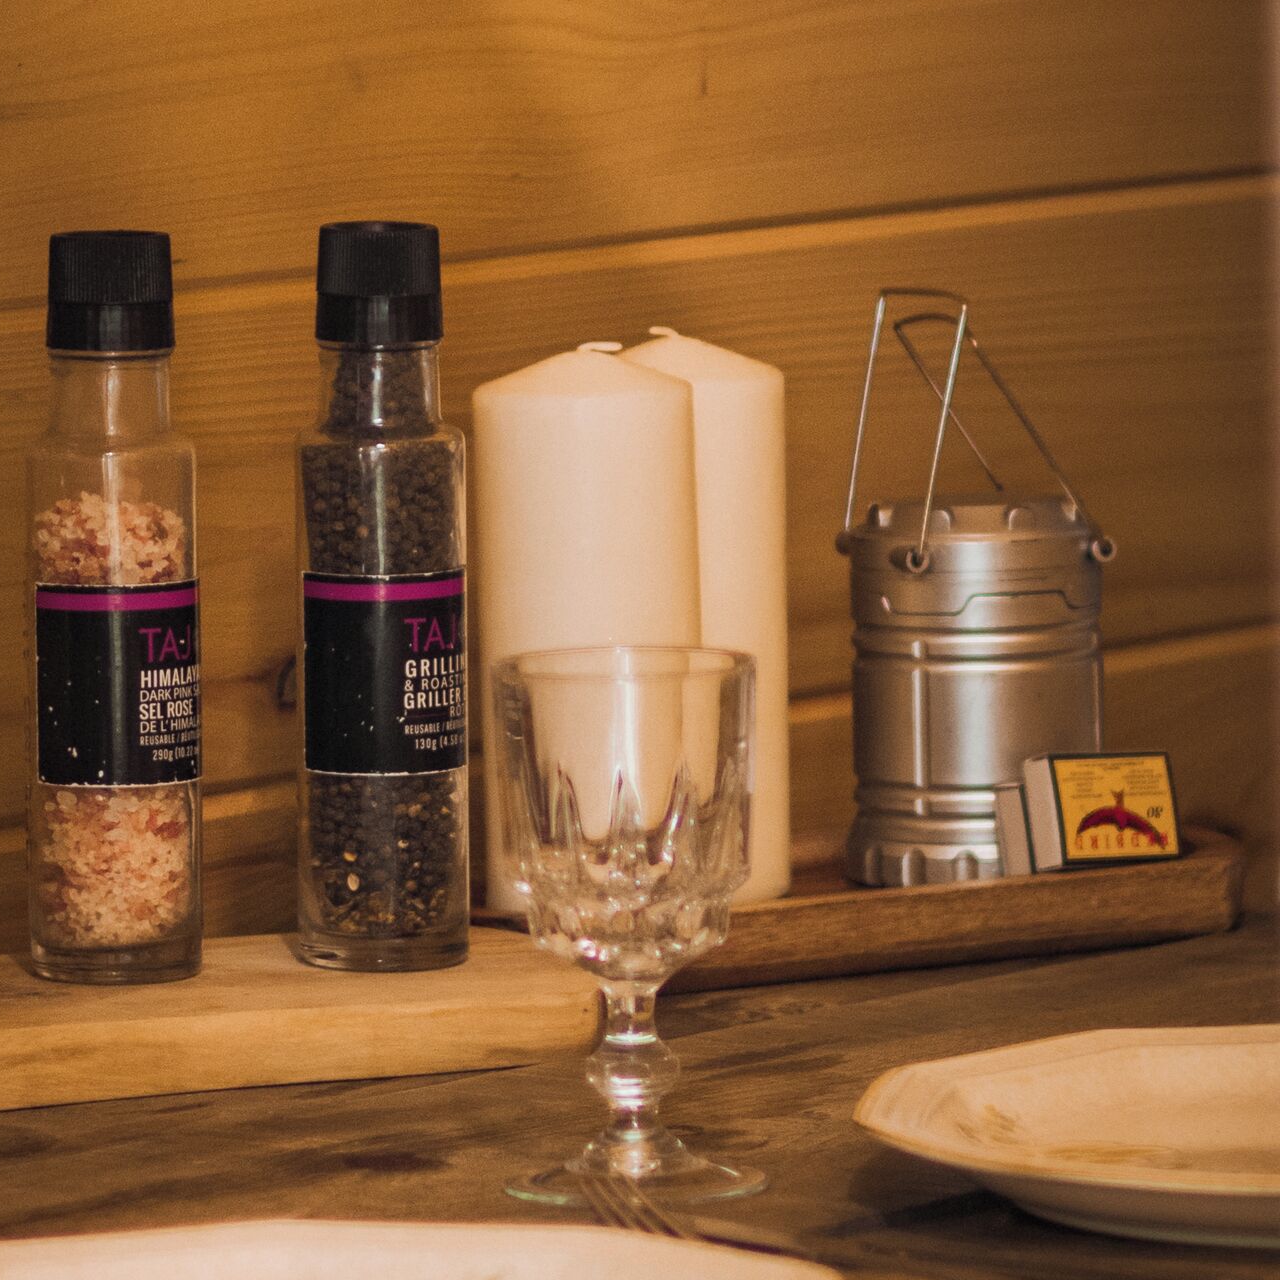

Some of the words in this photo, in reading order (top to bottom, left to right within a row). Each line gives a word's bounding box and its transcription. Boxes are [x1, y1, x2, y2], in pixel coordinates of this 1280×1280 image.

[404, 614, 457, 652] TAJ
[138, 624, 191, 663] TAJ
[404, 679, 414, 692] &
[140, 687, 172, 702] DARK
[173, 685, 193, 700] PINK
[404, 687, 461, 709] GRILLER
[139, 703, 164, 720] SEL
[166, 698, 193, 718] ROSE
[140, 720, 157, 734] DE
[404, 722, 440, 735] REUSABLE
[140, 733, 175, 746] REUSABLE
[415, 737, 437, 751] 130g
[152, 748, 174, 762] 290g
